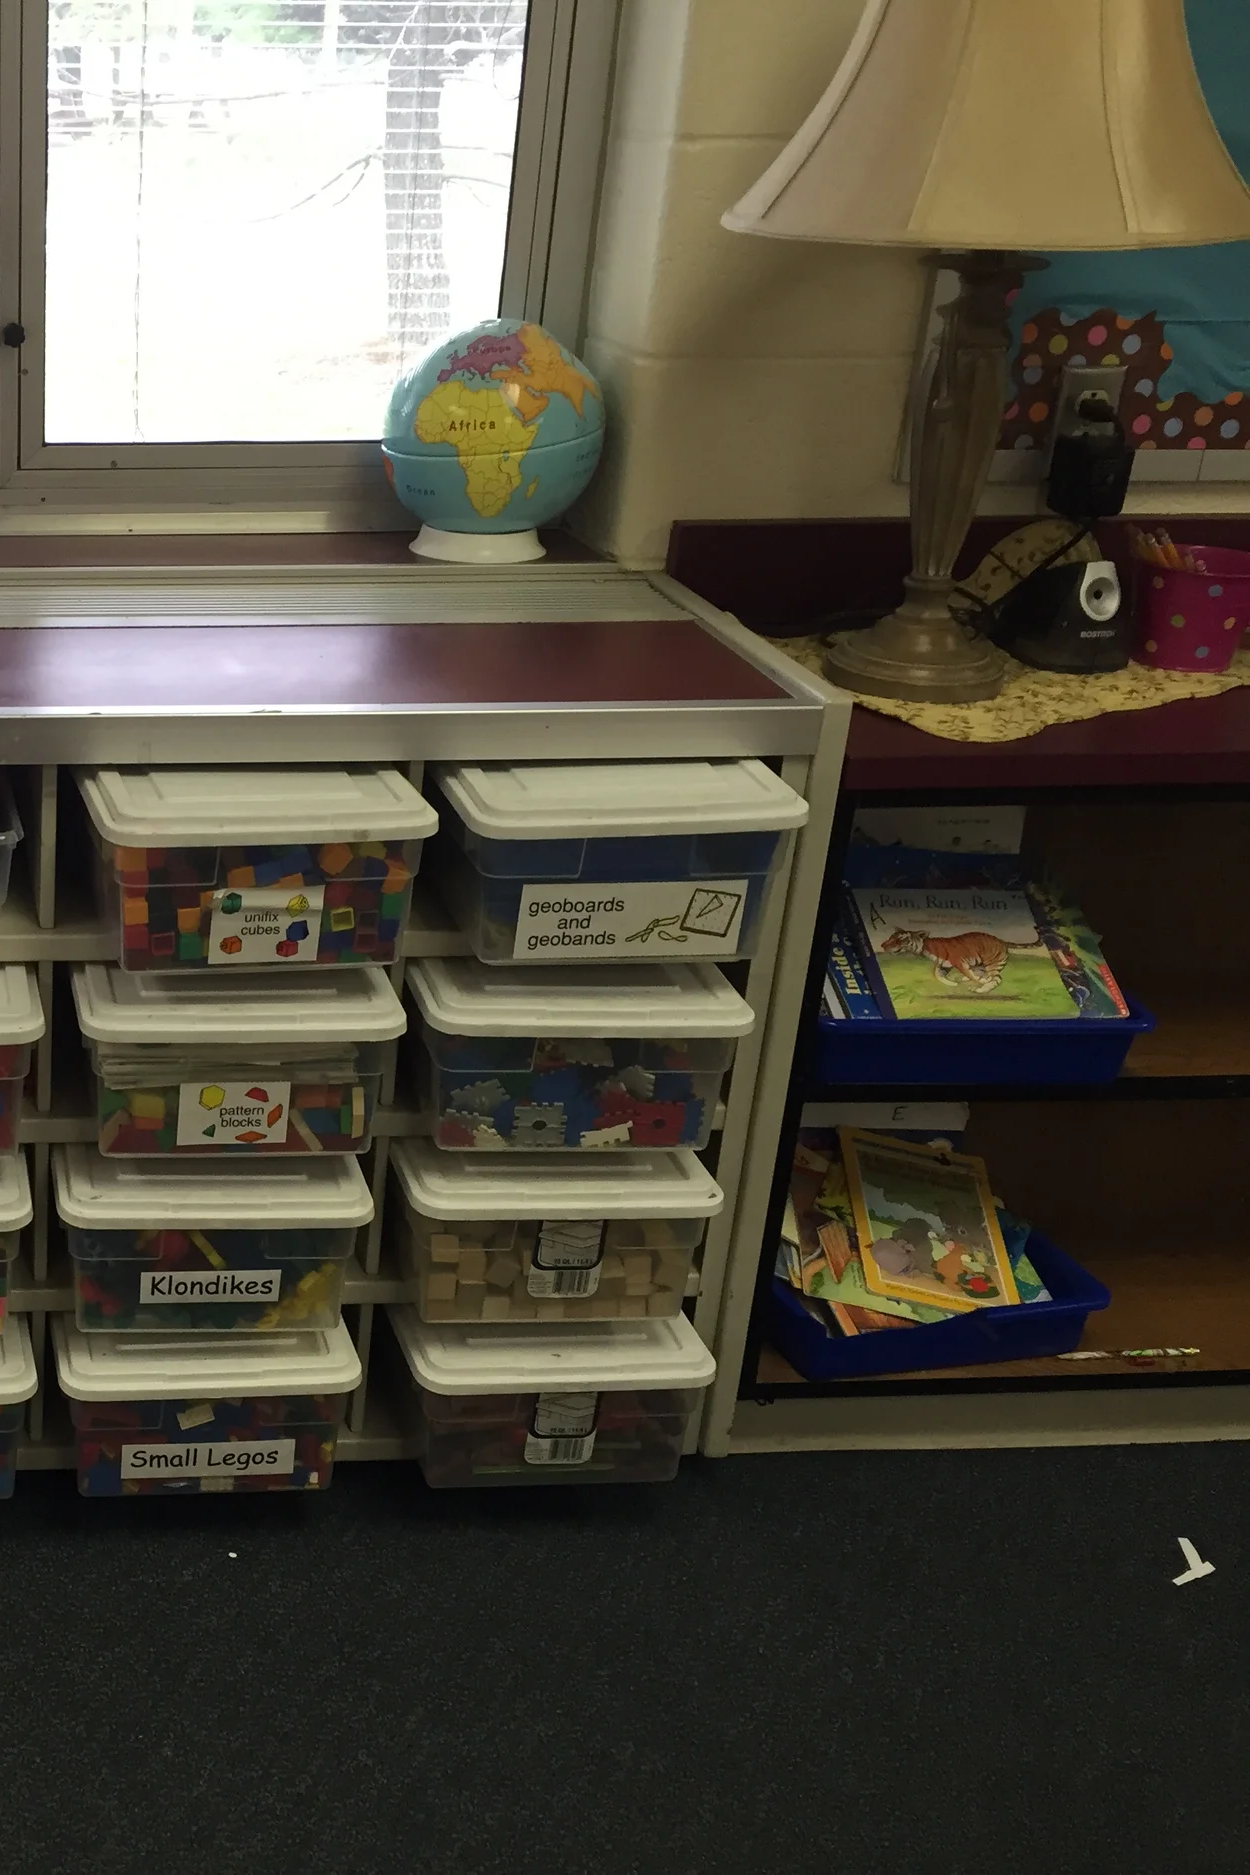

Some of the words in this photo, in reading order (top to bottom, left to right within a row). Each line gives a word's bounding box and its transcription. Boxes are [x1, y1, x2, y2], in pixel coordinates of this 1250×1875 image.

[449, 419, 496, 432] Africa
[528, 898, 625, 916] geoboards
[972, 895, 1008, 910] Run
[244, 911, 279, 923] unifix
[558, 915, 591, 930] and
[870, 902, 886, 930] A
[240, 925, 281, 936] cubes
[527, 931, 616, 950] geobands
[832, 946, 863, 995] Inside
[219, 1106, 265, 1118] pattern
[892, 1105, 908, 1121] E
[221, 1117, 261, 1128] blocks
[150, 1275, 273, 1297] Klondikes
[130, 1448, 198, 1469] Small
[207, 1447, 279, 1471] Legos
